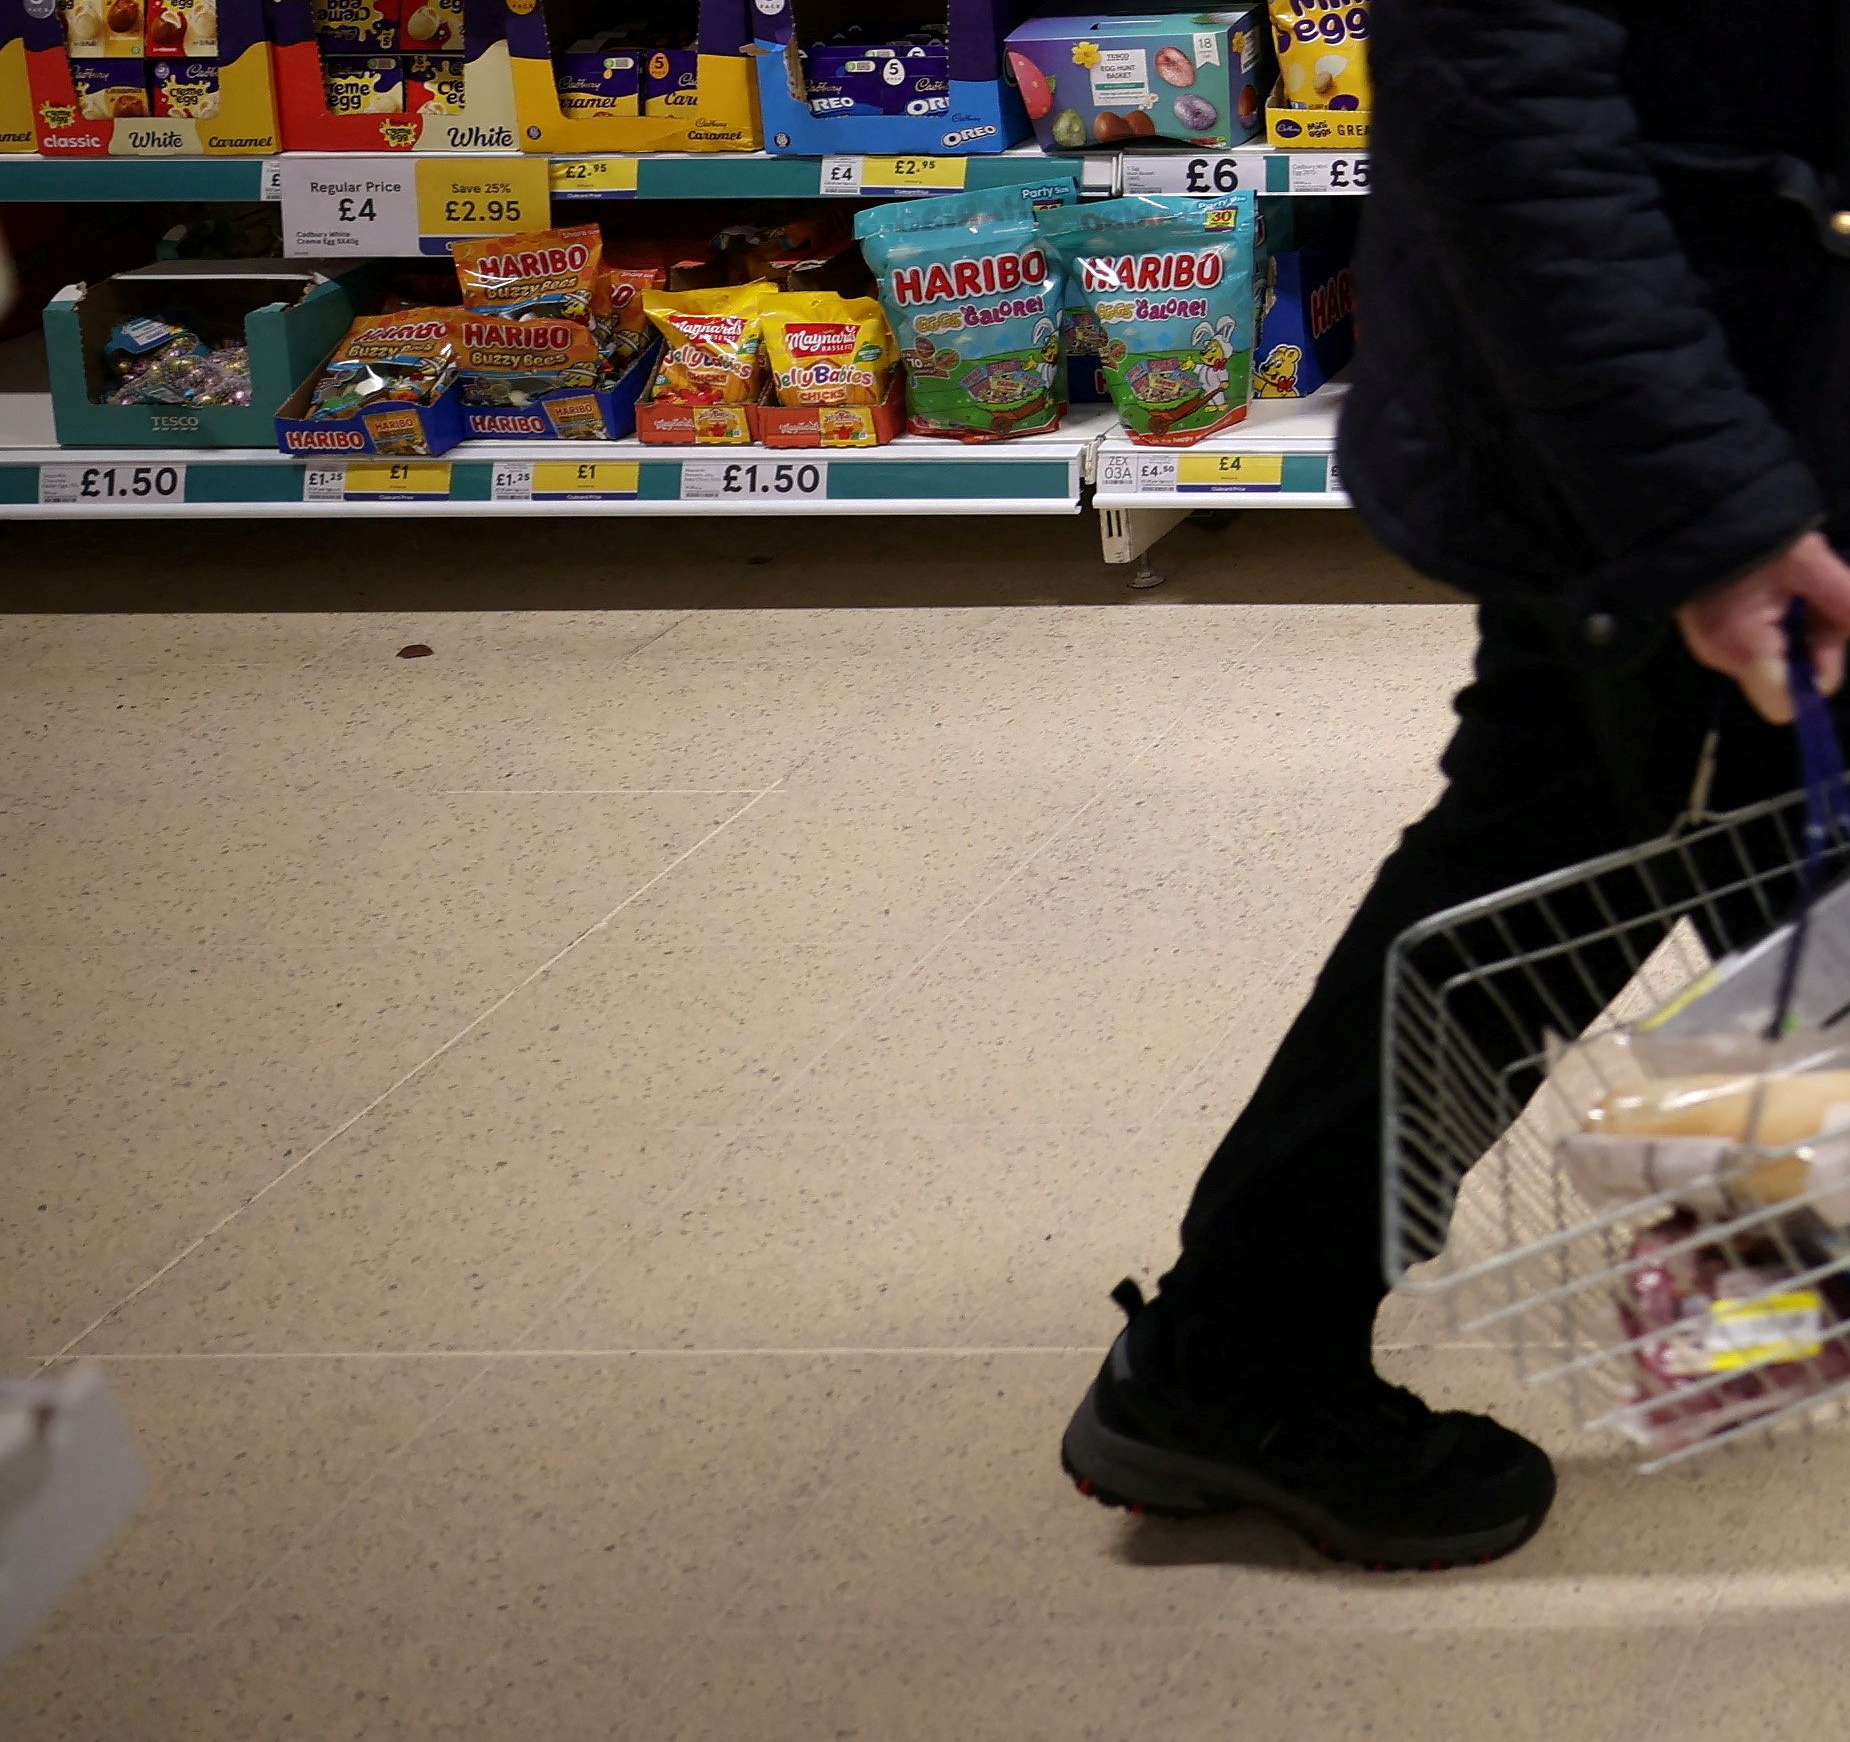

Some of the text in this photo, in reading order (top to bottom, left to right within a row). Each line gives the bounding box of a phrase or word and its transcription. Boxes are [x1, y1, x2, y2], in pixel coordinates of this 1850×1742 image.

[309, 181, 401, 195] Regular Price
[451, 182, 511, 194] Save 25%
[1186, 159, 1238, 193] £6
[338, 197, 377, 223] £4
[445, 199, 521, 223] £2.95
[478, 247, 586, 280] HARIBO
[79, 467, 178, 498] £1.50
